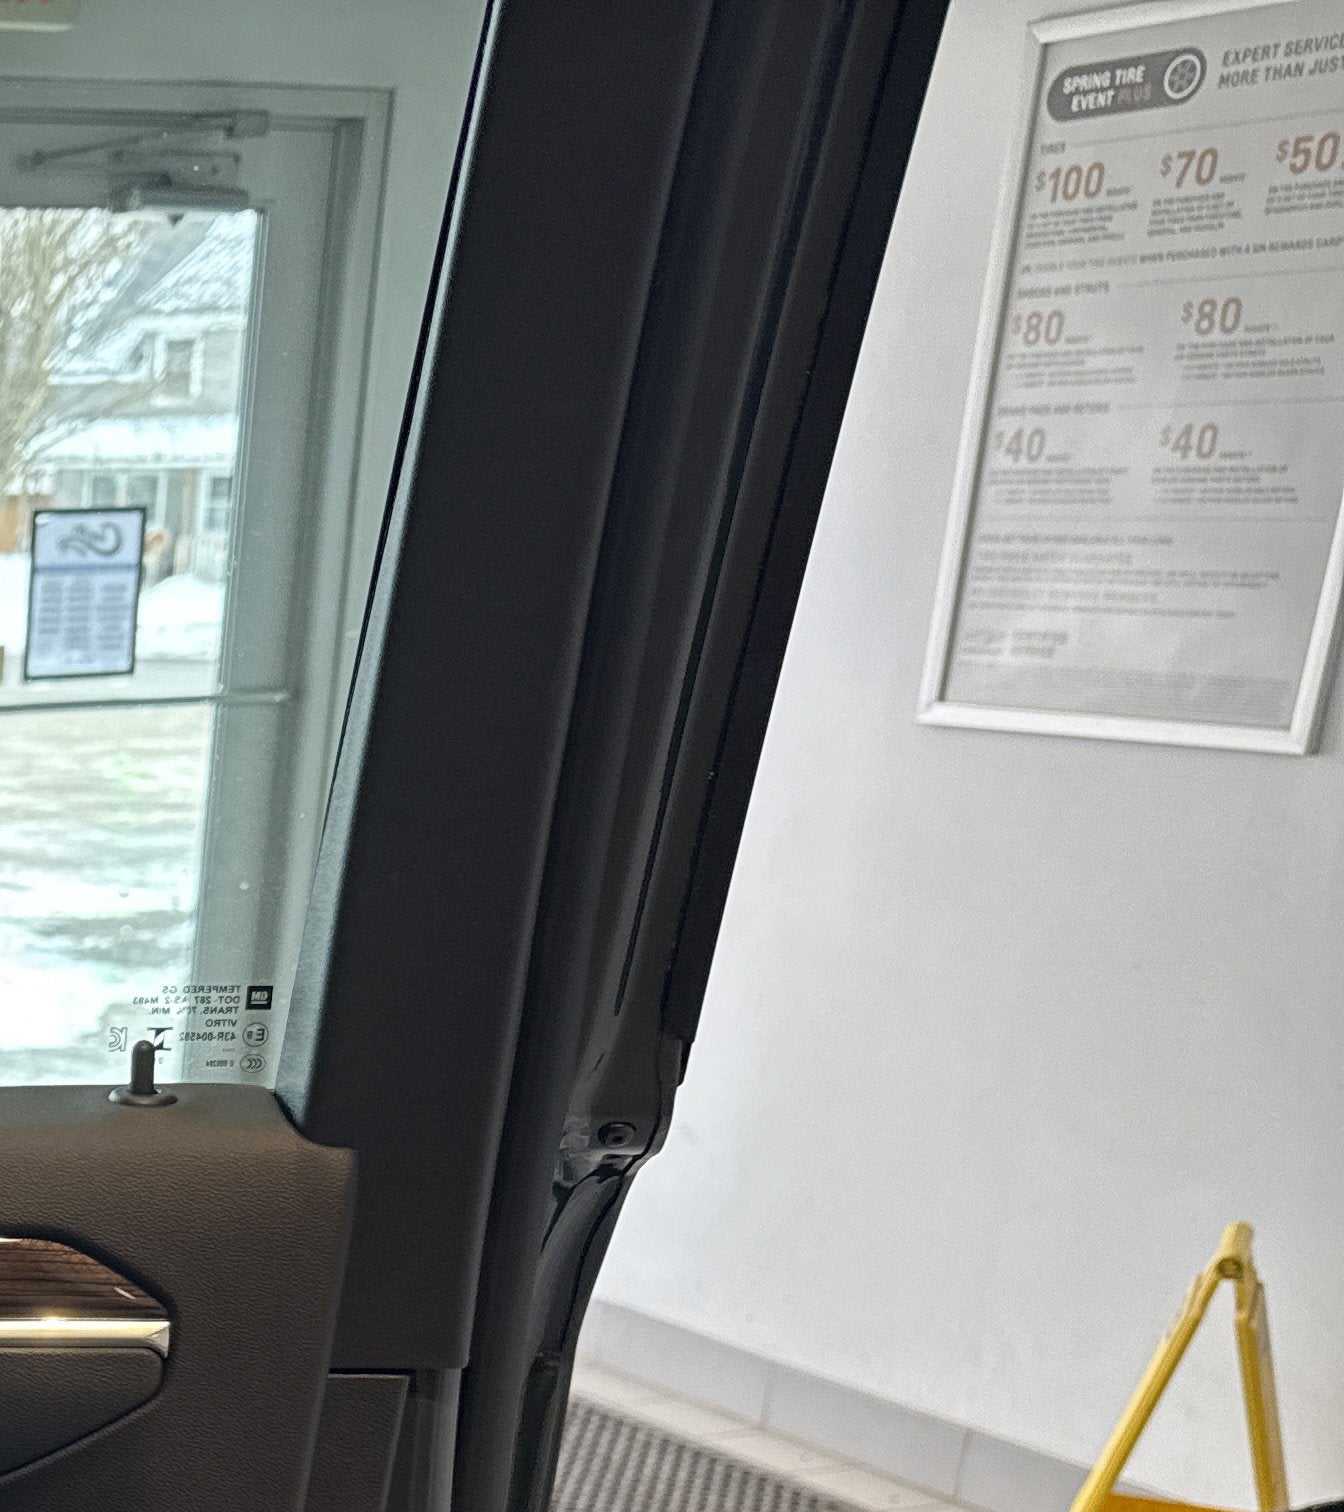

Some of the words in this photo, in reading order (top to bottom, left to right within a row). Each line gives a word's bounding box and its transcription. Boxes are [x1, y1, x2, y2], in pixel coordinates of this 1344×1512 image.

[1217, 66, 1260, 89] MORE
[1264, 60, 1305, 83] THAN
[1221, 43, 1281, 67] EXPERT
[1062, 70, 1112, 95] SPRING
[1113, 64, 1146, 85] TIRE
[1071, 90, 1116, 113] EVENT
[1160, 146, 1219, 190] $70
[1275, 130, 1342, 176] $50
[1035, 161, 1106, 203] $100
[1012, 308, 1065, 347] $80
[1180, 297, 1243, 336] $80
[993, 425, 1047, 464] $40
[1159, 421, 1219, 461] $40
